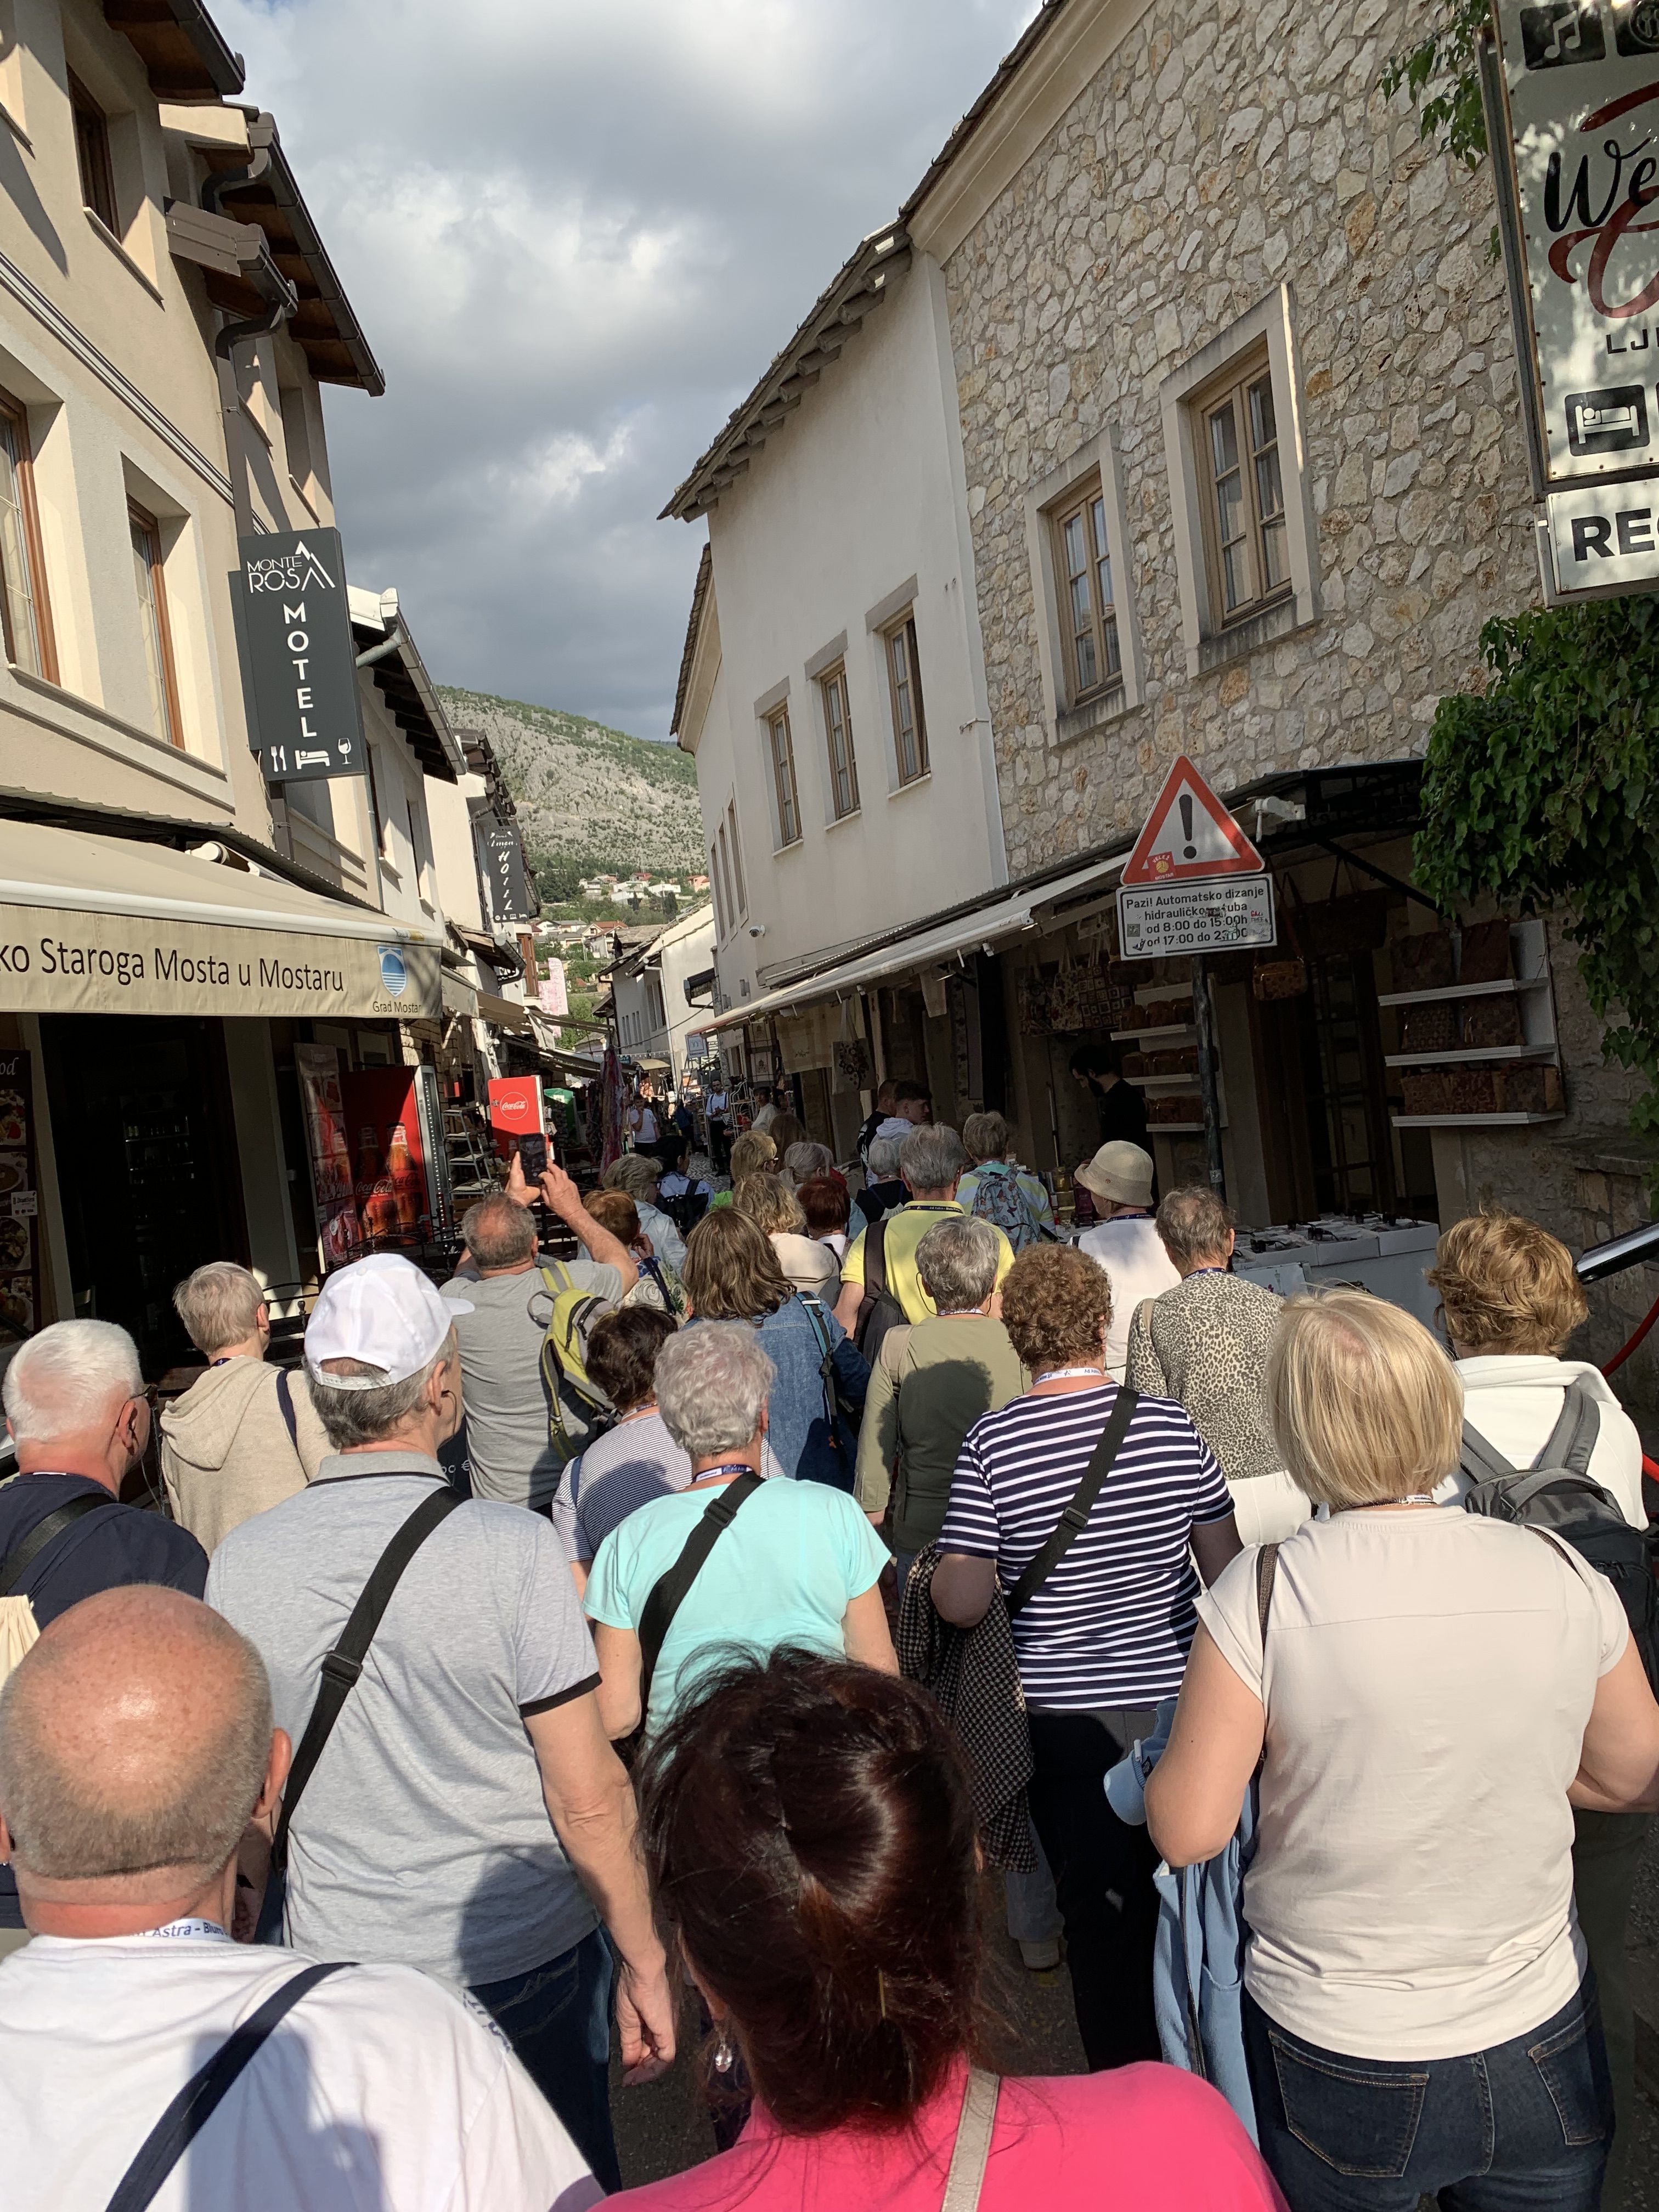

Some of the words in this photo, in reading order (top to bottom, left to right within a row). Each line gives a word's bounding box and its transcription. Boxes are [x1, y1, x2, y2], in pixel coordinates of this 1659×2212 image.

[1606, 326, 1659, 354] LJ
[1571, 508, 1659, 562] RE
[247, 555, 302, 573] MONTE
[249, 565, 328, 593] ROSA
[283, 601, 317, 737] MOTEL
[1126, 898, 1152, 909] Pazi!
[1156, 891, 1222, 906] Automatsko
[1225, 887, 1264, 899] dizanje
[1145, 906, 1213, 921] hidrauličko
[1147, 923, 1160, 933] od
[1163, 921, 1190, 932] 8:00
[1193, 919, 1206, 929] do
[1210, 915, 1248, 927] 15:00h
[1147, 936, 1160, 947] od
[1163, 933, 1194, 945] 17:00
[1197, 932, 1210, 942] do
[41, 938, 144, 985] Staroga
[155, 948, 229, 985] Mosta
[239, 963, 251, 986] u
[259, 958, 344, 991] Mostaru
[373, 1001, 392, 1012] Grad
[394, 1002, 421, 1013] Mostar
